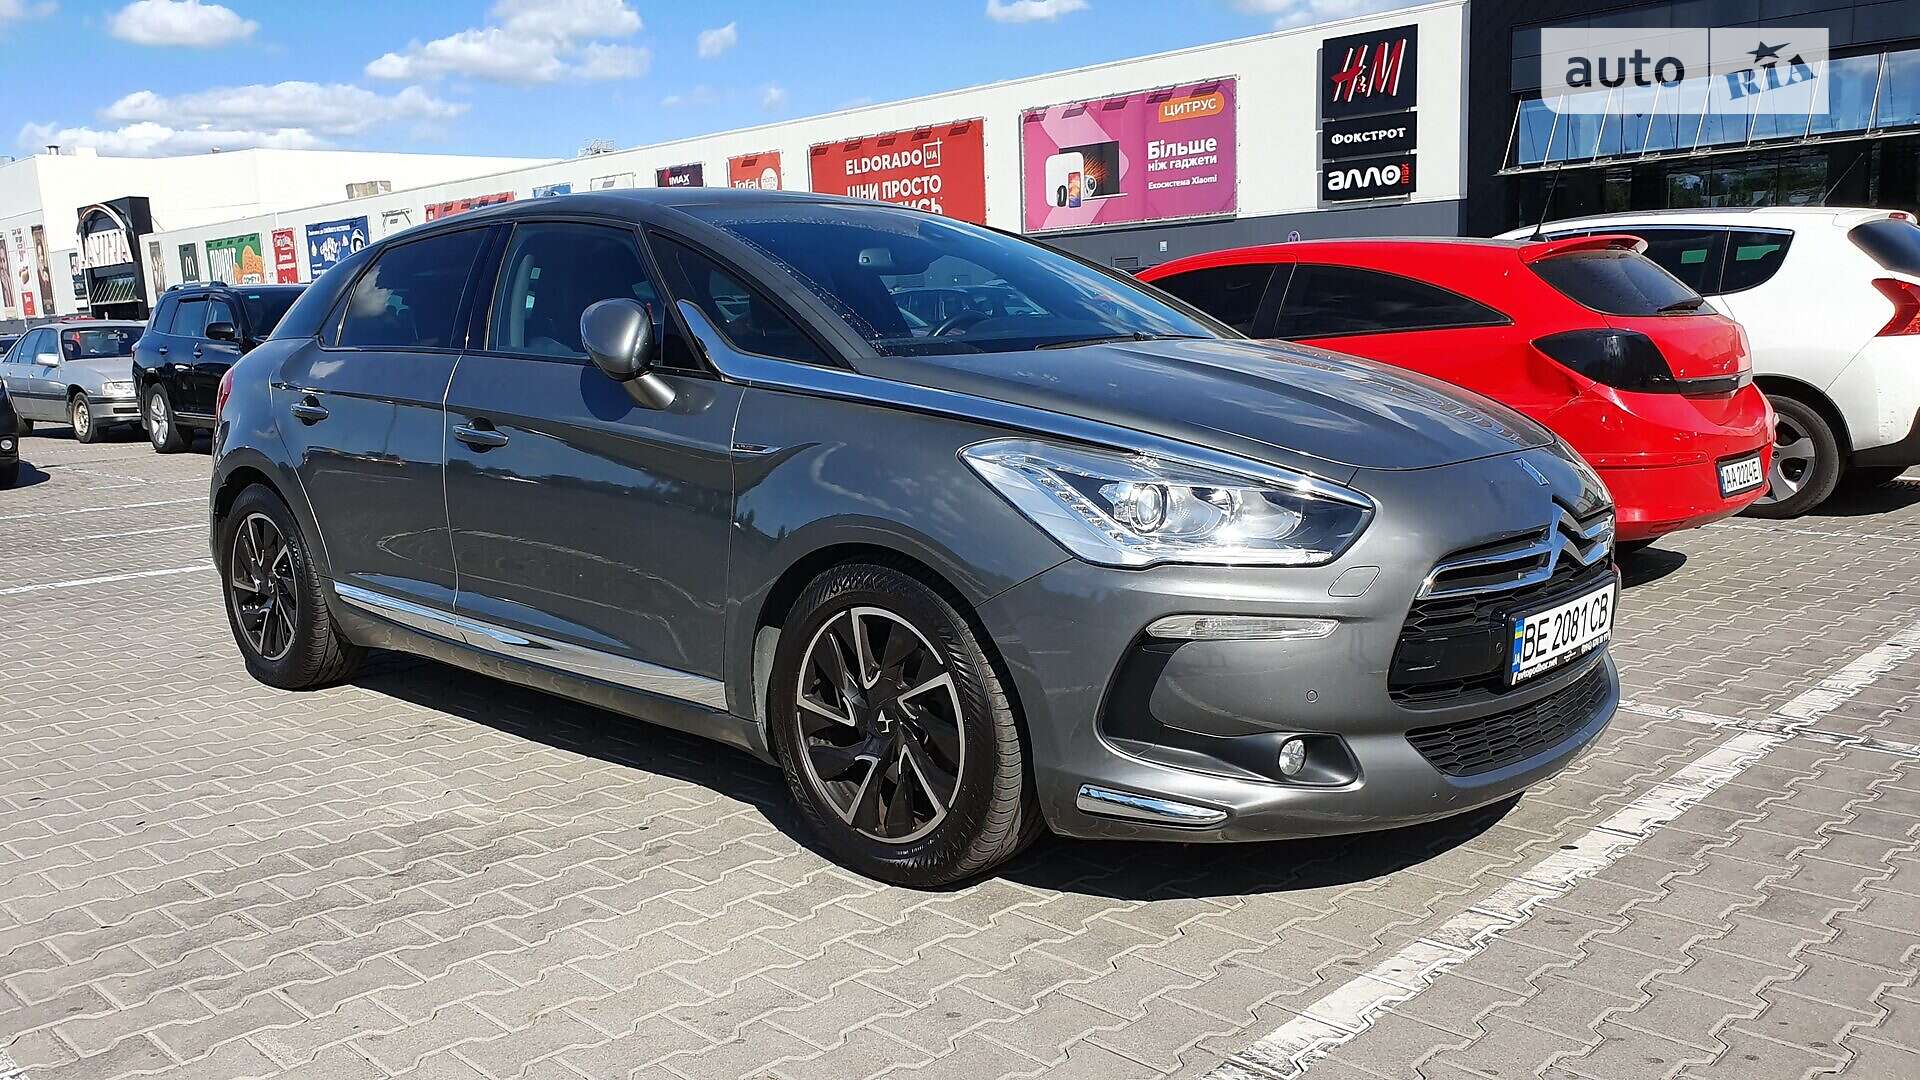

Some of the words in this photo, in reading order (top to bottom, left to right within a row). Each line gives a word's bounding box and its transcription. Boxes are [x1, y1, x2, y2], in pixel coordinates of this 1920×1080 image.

[1330, 38, 1407, 103] H&M
[1164, 98, 1217, 116] ЦИТРУС
[1331, 127, 1407, 145] ФОКСТРОТ
[1147, 137, 1218, 160] Більше
[845, 149, 922, 175] ELDORADO
[926, 150, 938, 160] UA
[1148, 159, 1168, 172] ніж
[1169, 154, 1217, 170] гаджети
[668, 173, 690, 186] IMAX
[734, 178, 759, 189] Total
[882, 175, 942, 200] ПРОСТО
[1191, 174, 1218, 185] Xiaomi
[1522, 617, 1550, 662] BE
[1551, 602, 1588, 651] 2081
[1590, 593, 1609, 633] CB
